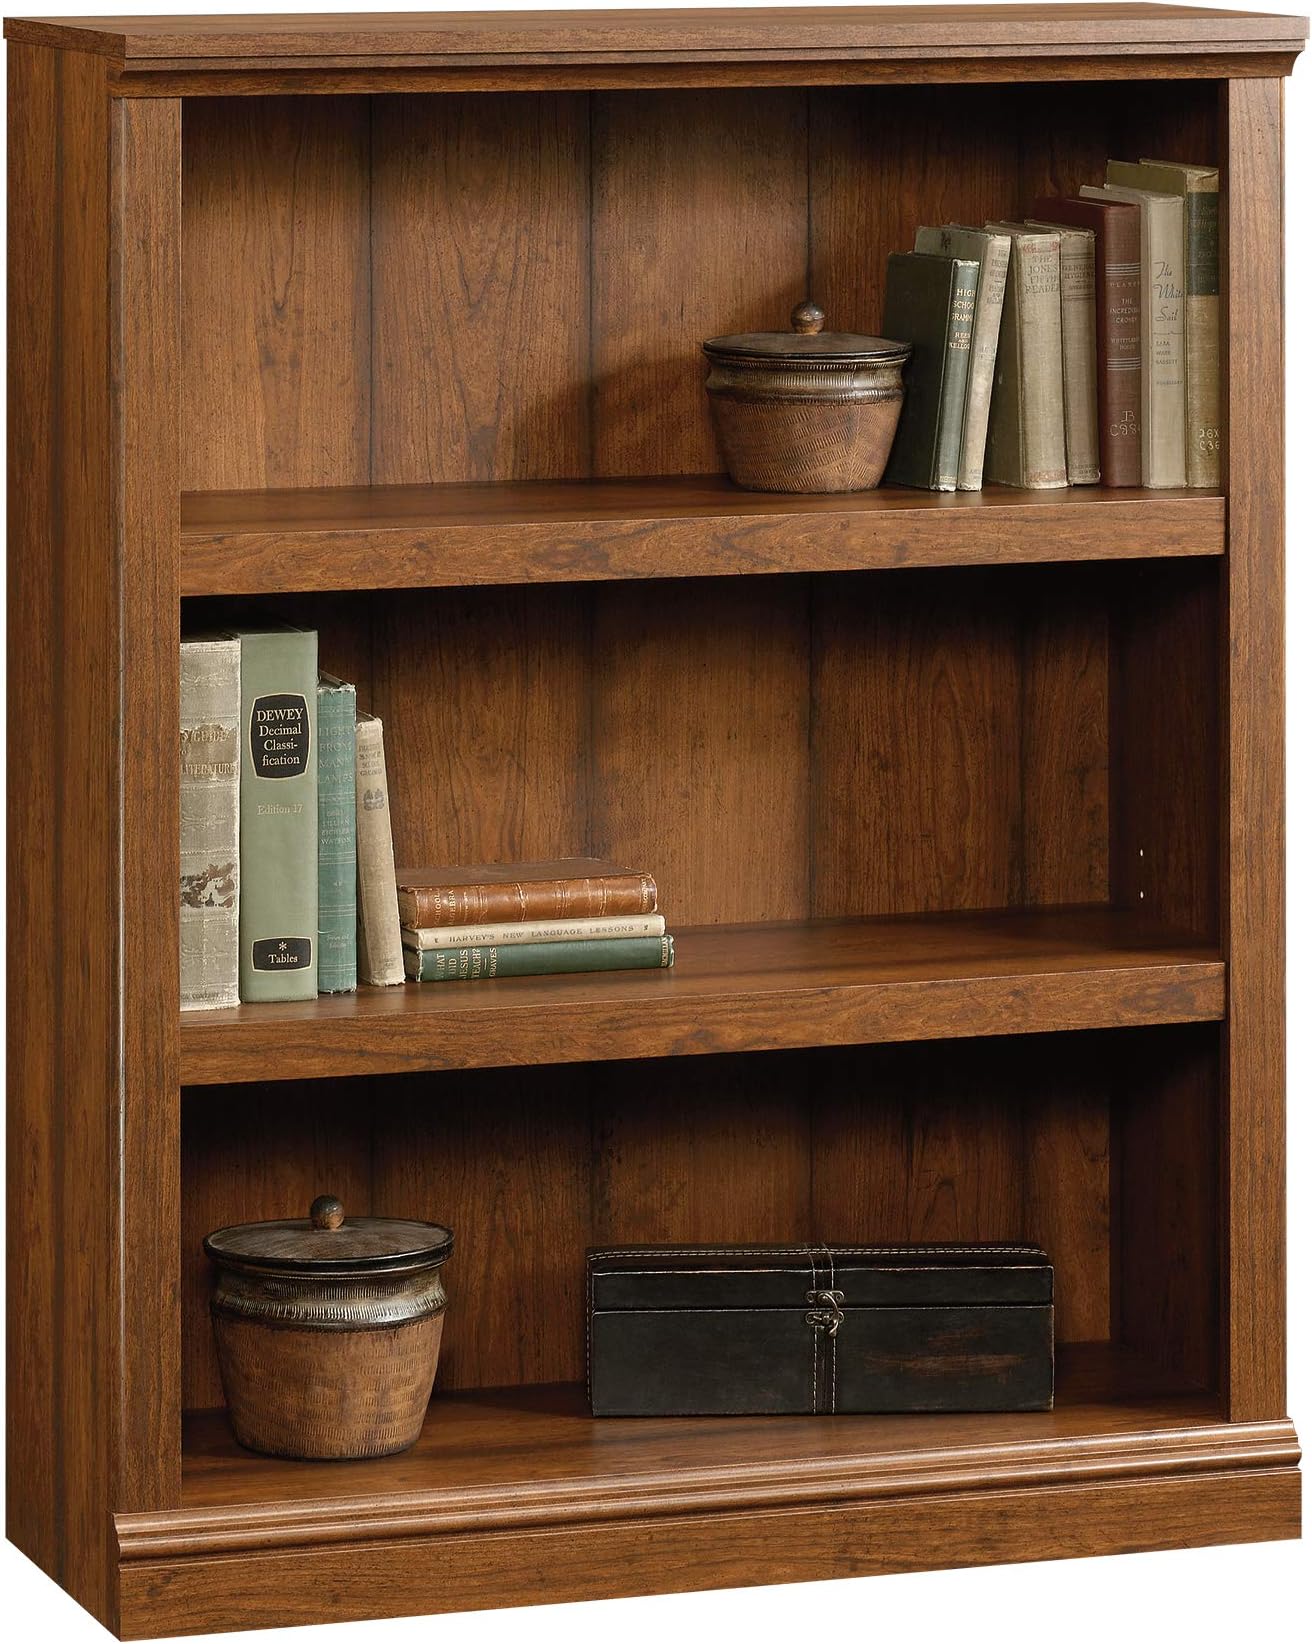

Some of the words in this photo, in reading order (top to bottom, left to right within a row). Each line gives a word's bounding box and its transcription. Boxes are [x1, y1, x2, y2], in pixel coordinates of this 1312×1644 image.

[1028, 263, 1057, 276] JONES
[1153, 261, 1173, 279] The
[1152, 283, 1184, 299] White
[952, 300, 975, 310] SCHOO
[1155, 306, 1178, 322] Sail
[257, 708, 304, 722] DEWEY
[259, 723, 302, 737] Decimal
[263, 738, 299, 751] Classi-
[262, 753, 300, 766] fication
[257, 803, 290, 815] Edition
[293, 803, 303, 813] 17
[449, 933, 495, 943] HARVEY'S
[502, 931, 524, 939] NEW
[531, 928, 583, 938] LANGUAGE
[589, 925, 634, 934] LESSONS
[267, 953, 298, 964] Tables
